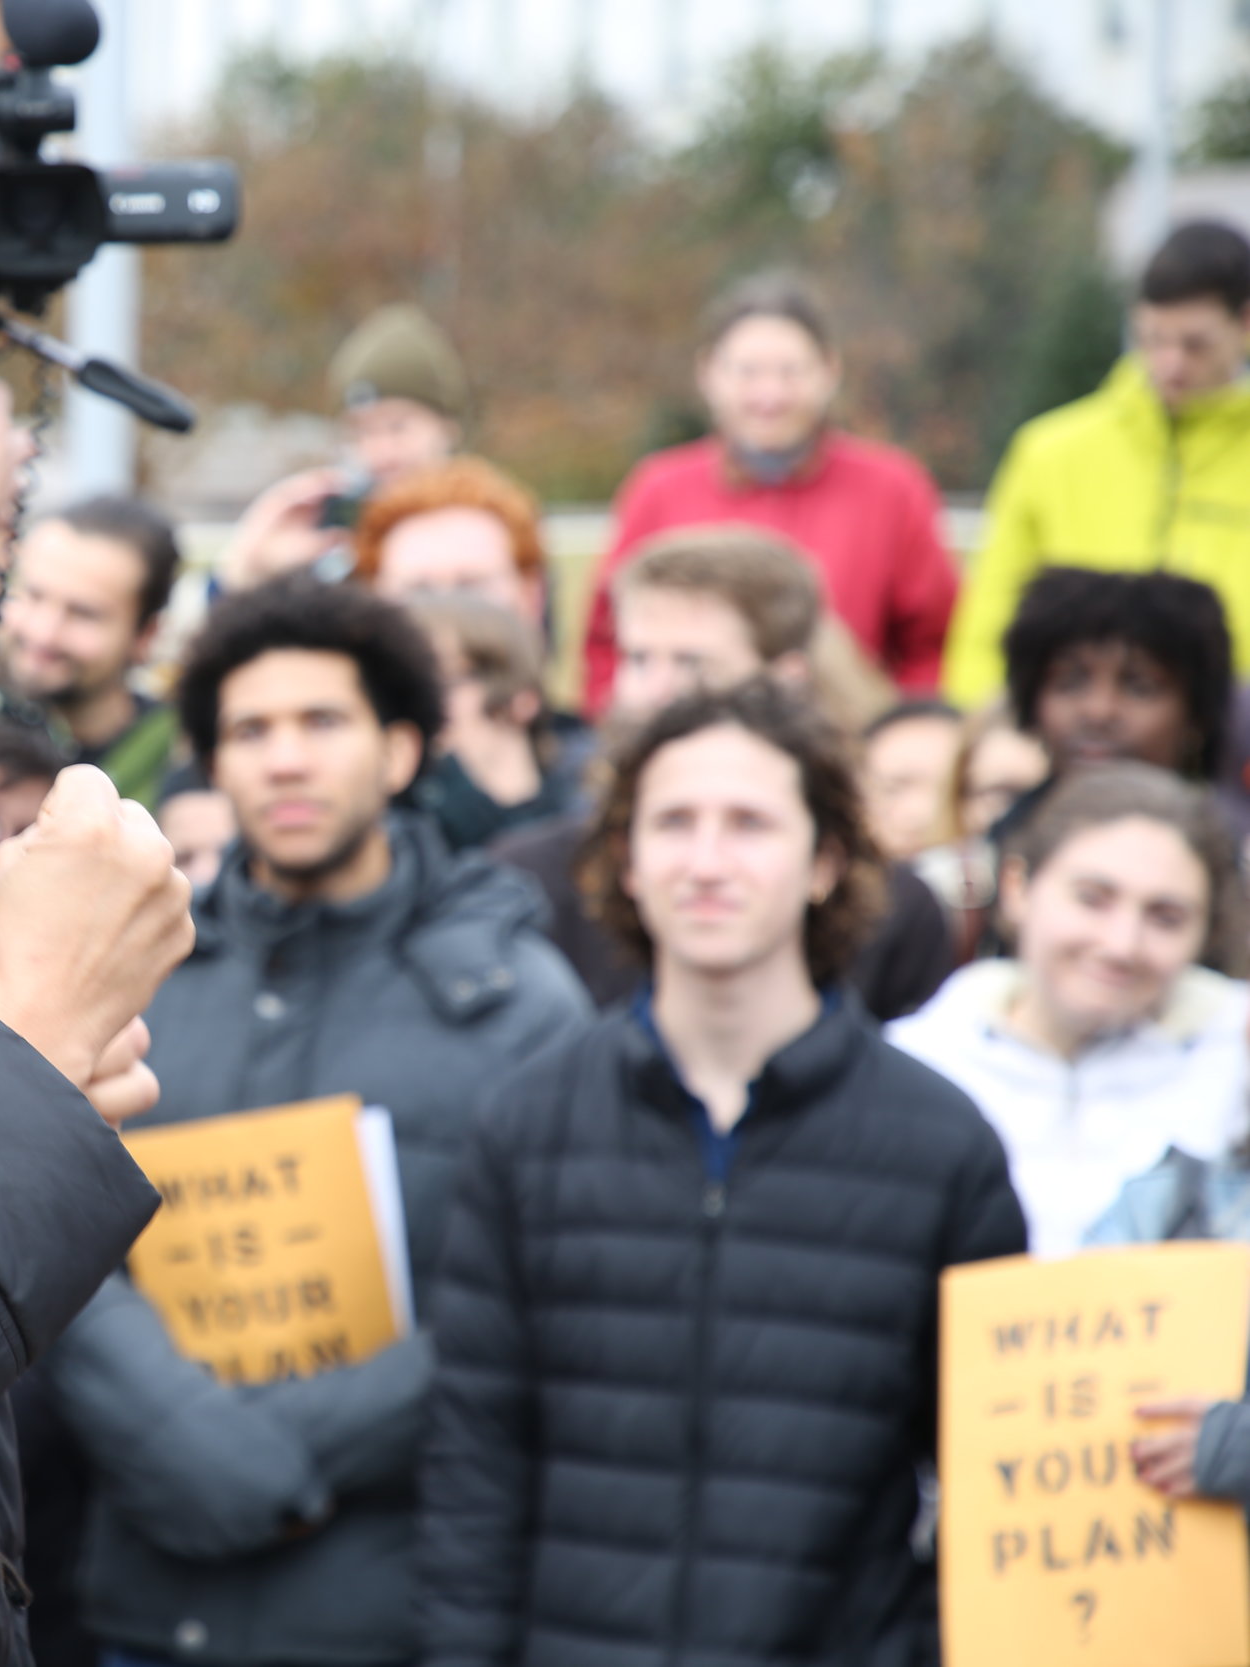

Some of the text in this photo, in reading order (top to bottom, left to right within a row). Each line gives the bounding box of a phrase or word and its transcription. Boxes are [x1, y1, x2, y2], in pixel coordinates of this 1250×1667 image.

[180, 1275, 335, 1335] YOUR
[990, 1302, 1164, 1353] WHAT
[993, 1436, 1142, 1497] YOU
[992, 1502, 1180, 1575] PLAN
[1070, 1587, 1099, 1645] ?
